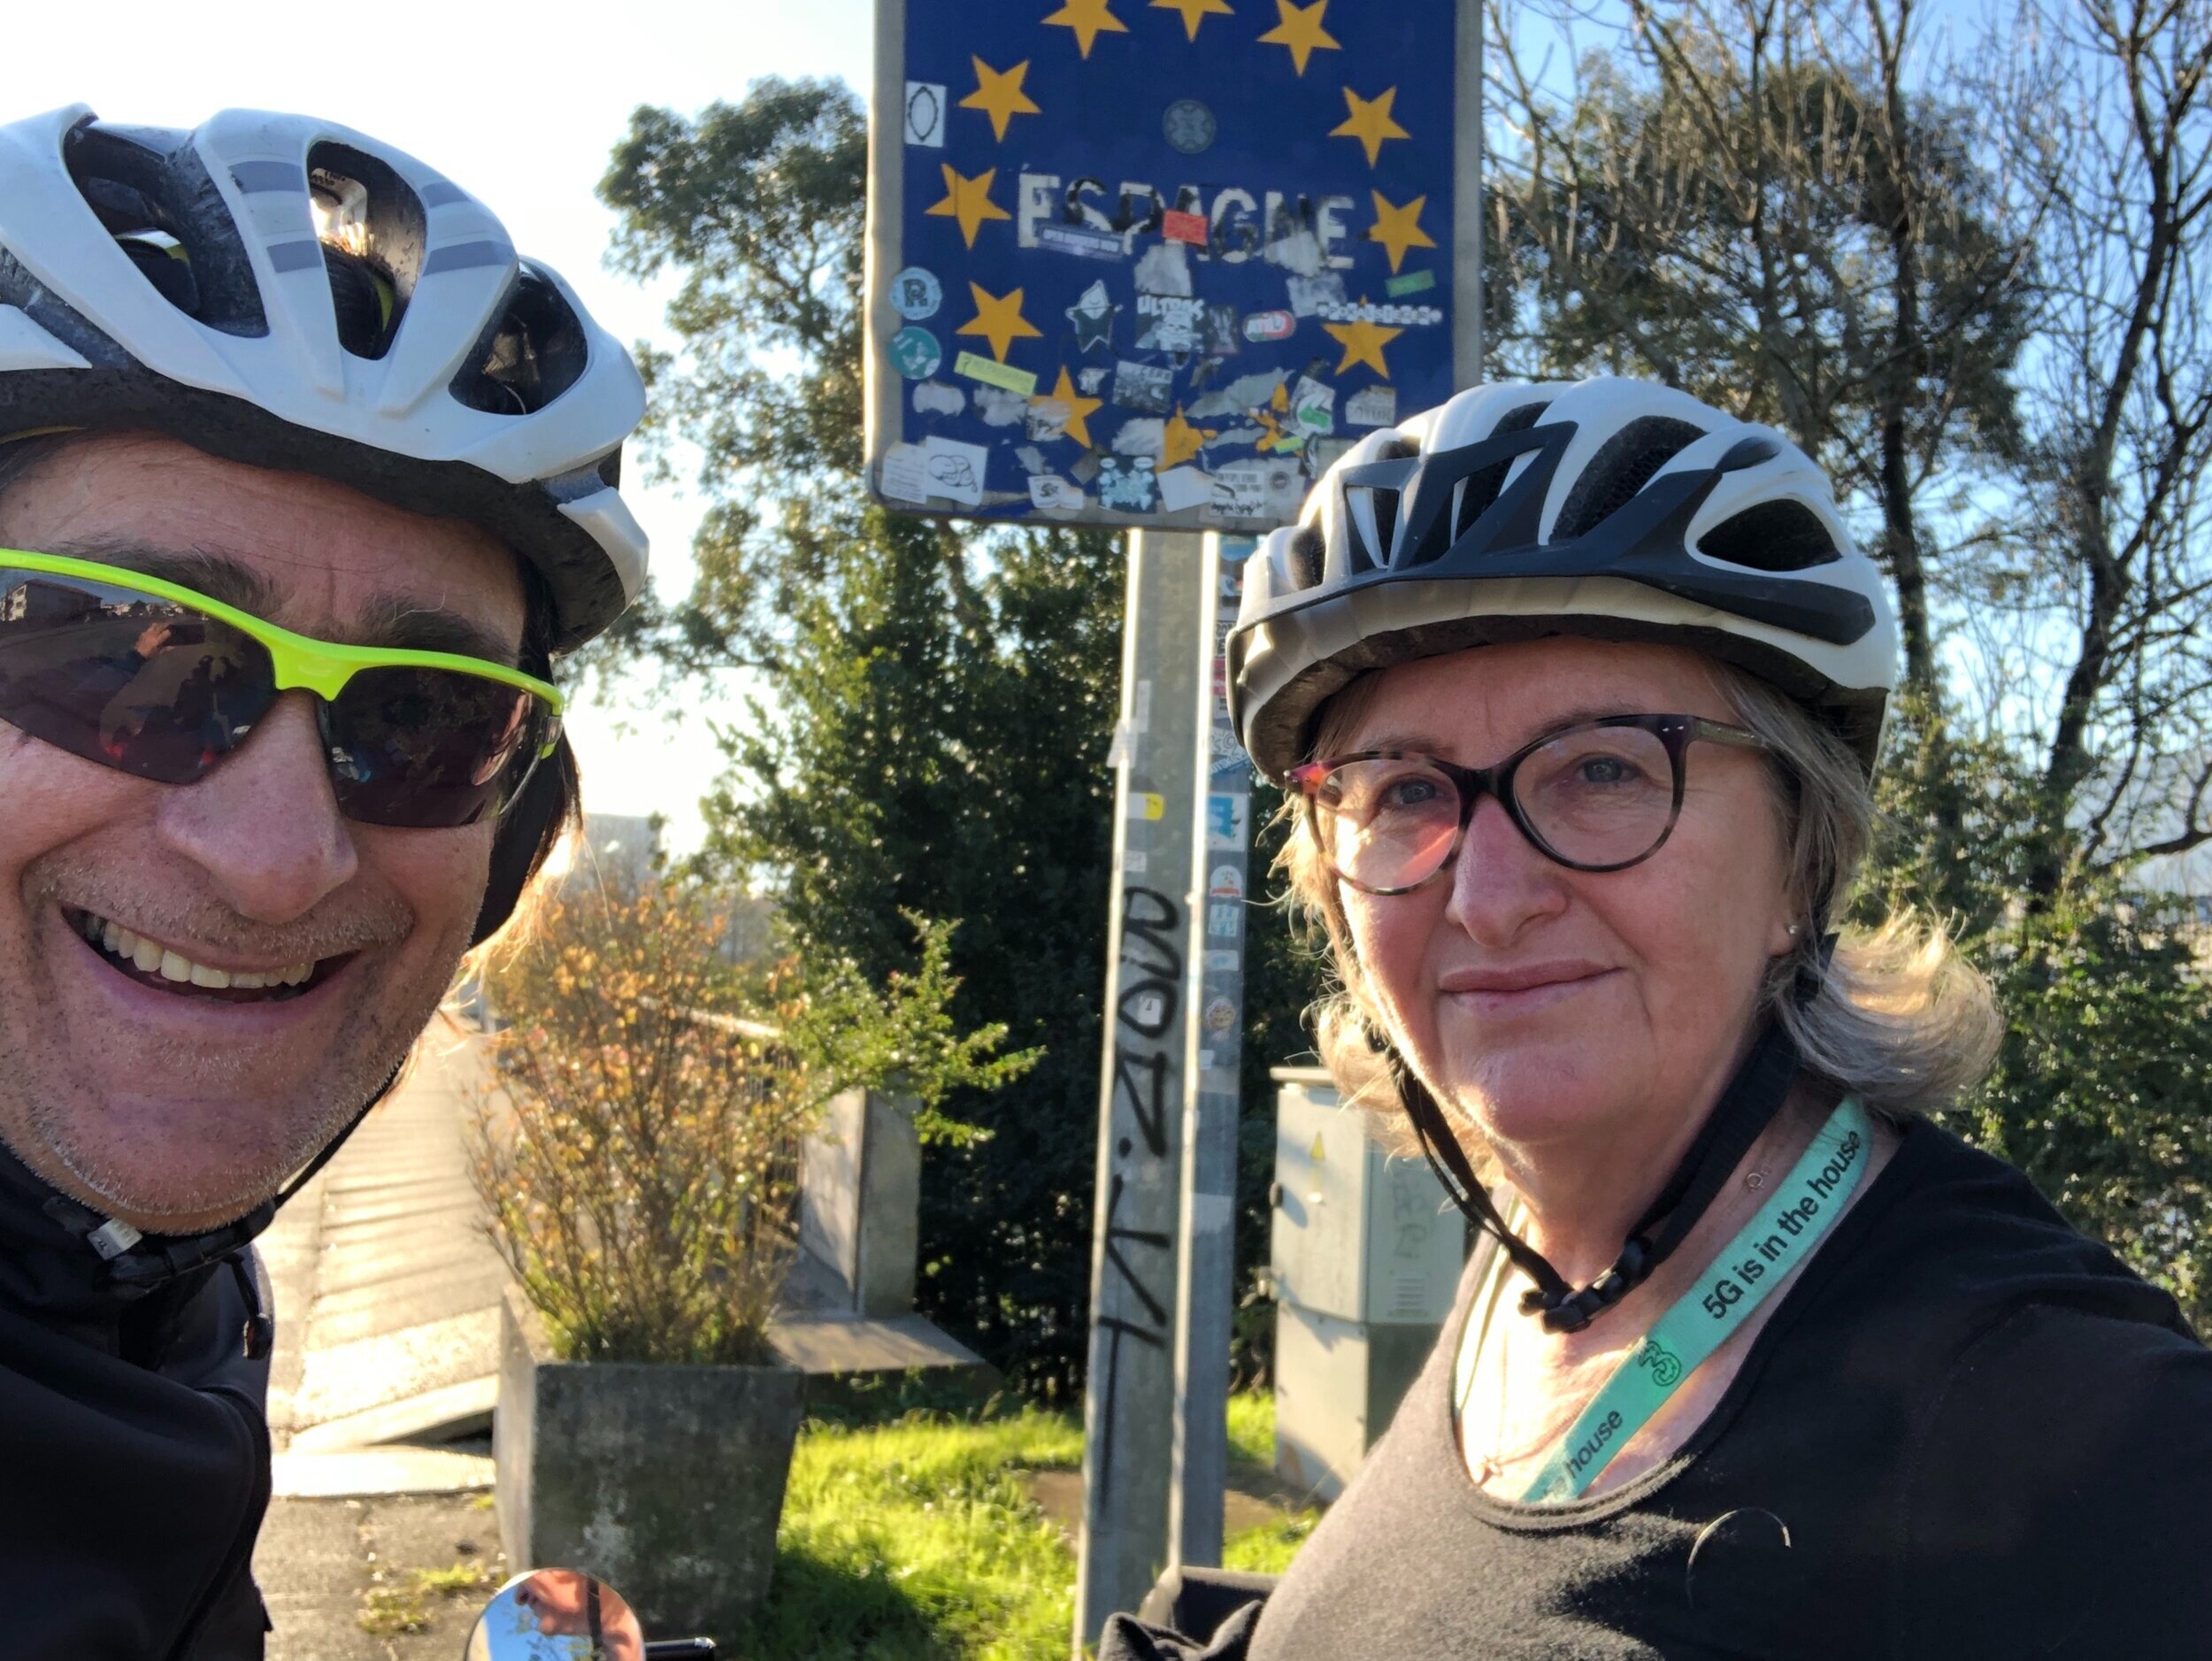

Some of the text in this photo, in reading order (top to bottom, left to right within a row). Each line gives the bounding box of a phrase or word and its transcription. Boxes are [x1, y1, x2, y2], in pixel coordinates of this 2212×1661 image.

[1702, 1130, 1861, 1319] 5G is in the house
[1564, 1411, 1623, 1479] house
